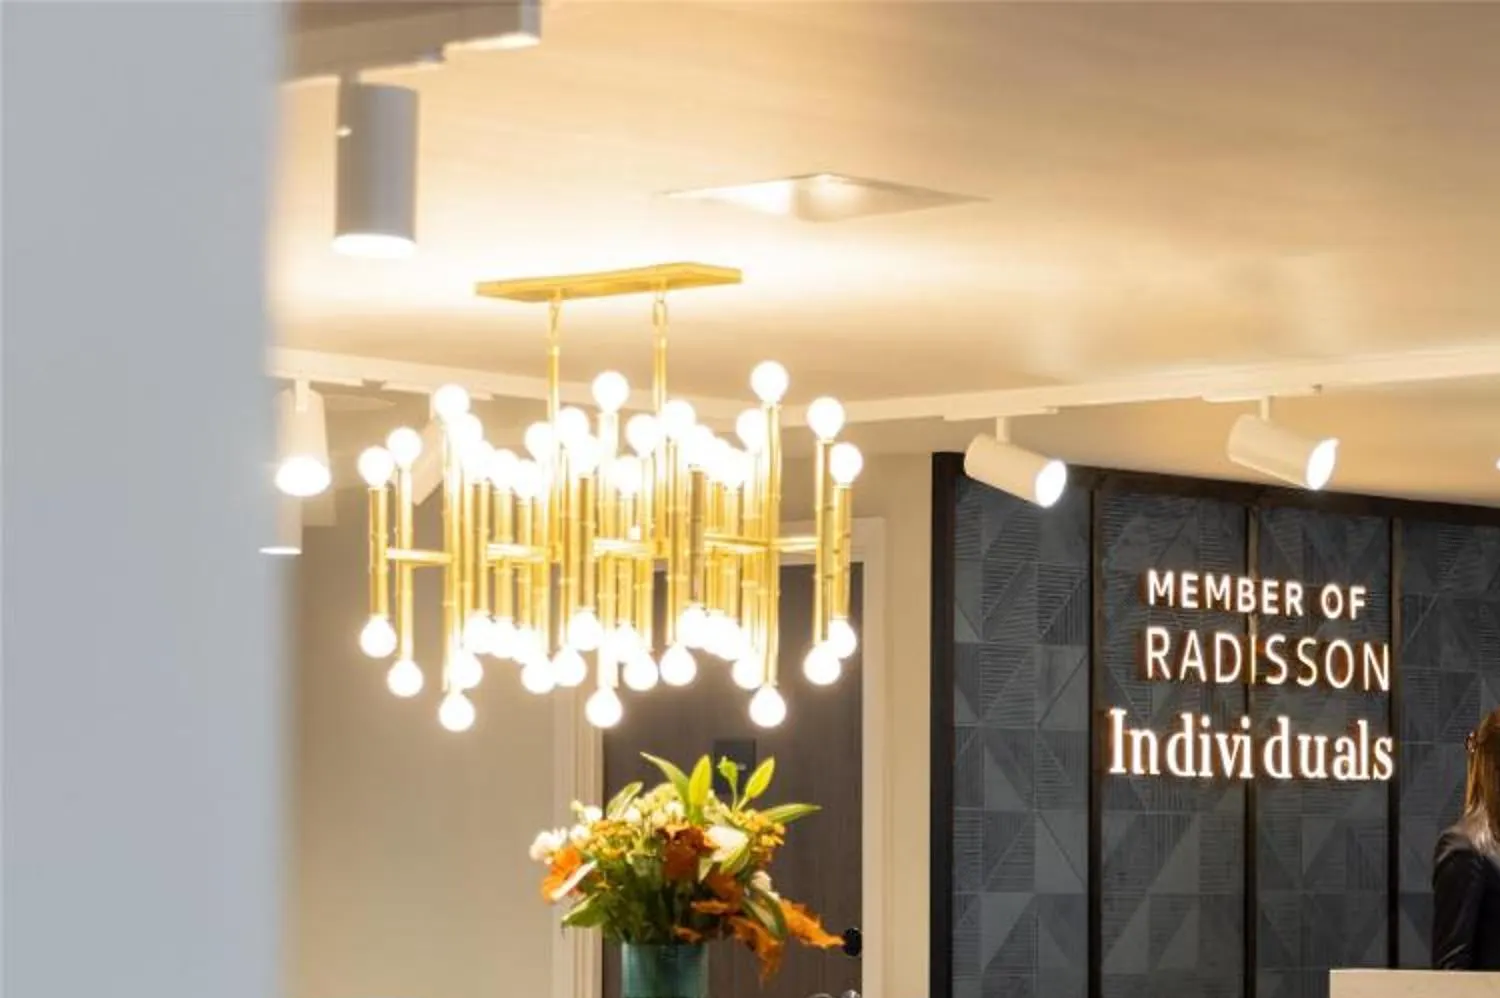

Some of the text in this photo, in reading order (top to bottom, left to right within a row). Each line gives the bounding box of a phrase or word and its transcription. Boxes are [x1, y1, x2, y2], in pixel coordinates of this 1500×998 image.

[1147, 569, 1367, 620] MEMBER OF
[1146, 626, 1390, 692] RADISSON
[1107, 707, 1394, 781] Individuals
